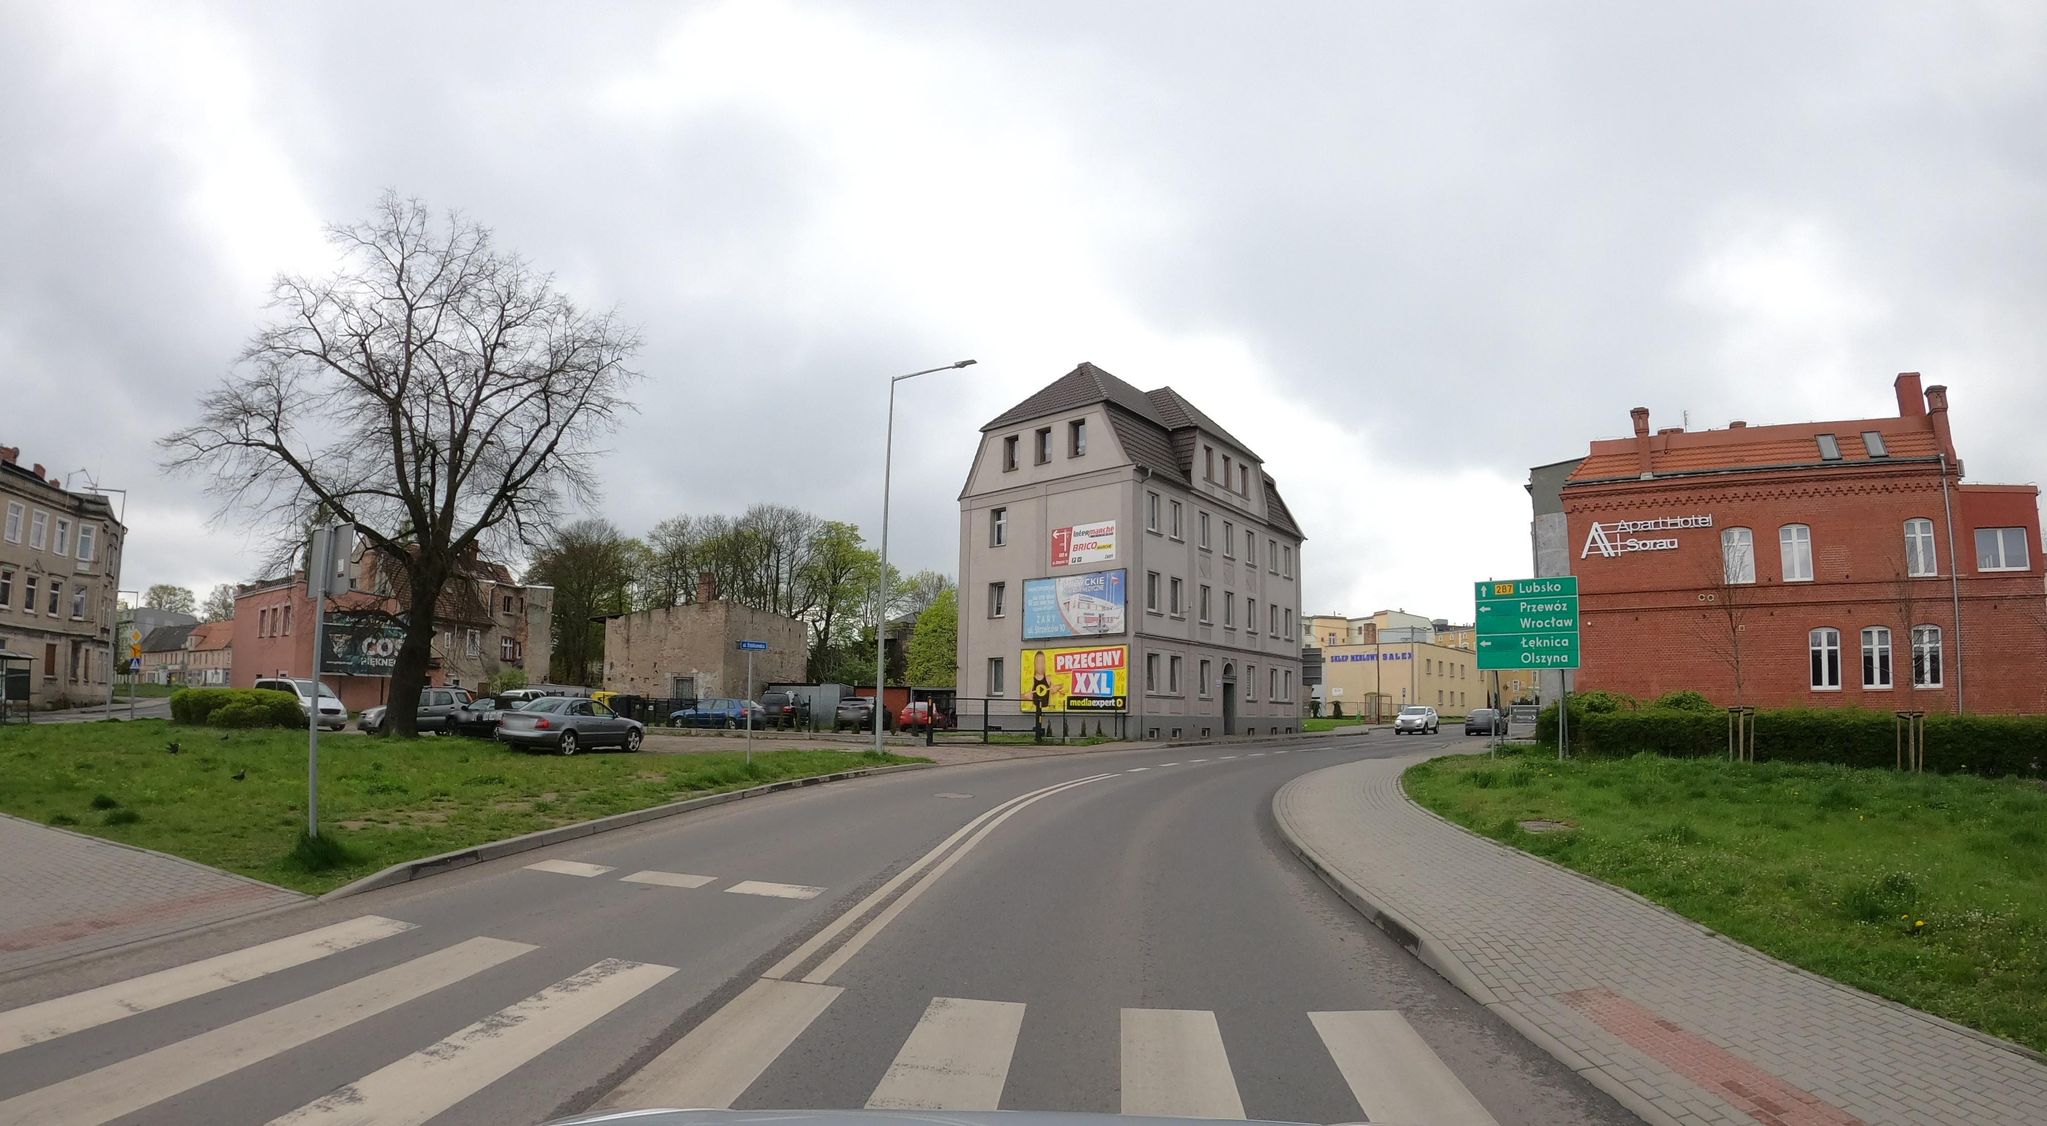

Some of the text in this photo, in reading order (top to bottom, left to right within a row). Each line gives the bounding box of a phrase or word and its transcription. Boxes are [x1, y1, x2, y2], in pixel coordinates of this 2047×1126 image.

[1626, 538, 1679, 552] Sorau
[1496, 581, 1562, 594] 287 Lubsko
[1520, 600, 1568, 613] Przewóz
[1520, 616, 1573, 629] Wrocław
[1520, 636, 1569, 649] Łęknica
[1056, 650, 1122, 671] PRZECENY
[1521, 652, 1569, 666] Olszyna
[1073, 672, 1111, 695] XXL
[1069, 698, 1116, 708] mediaexpert
